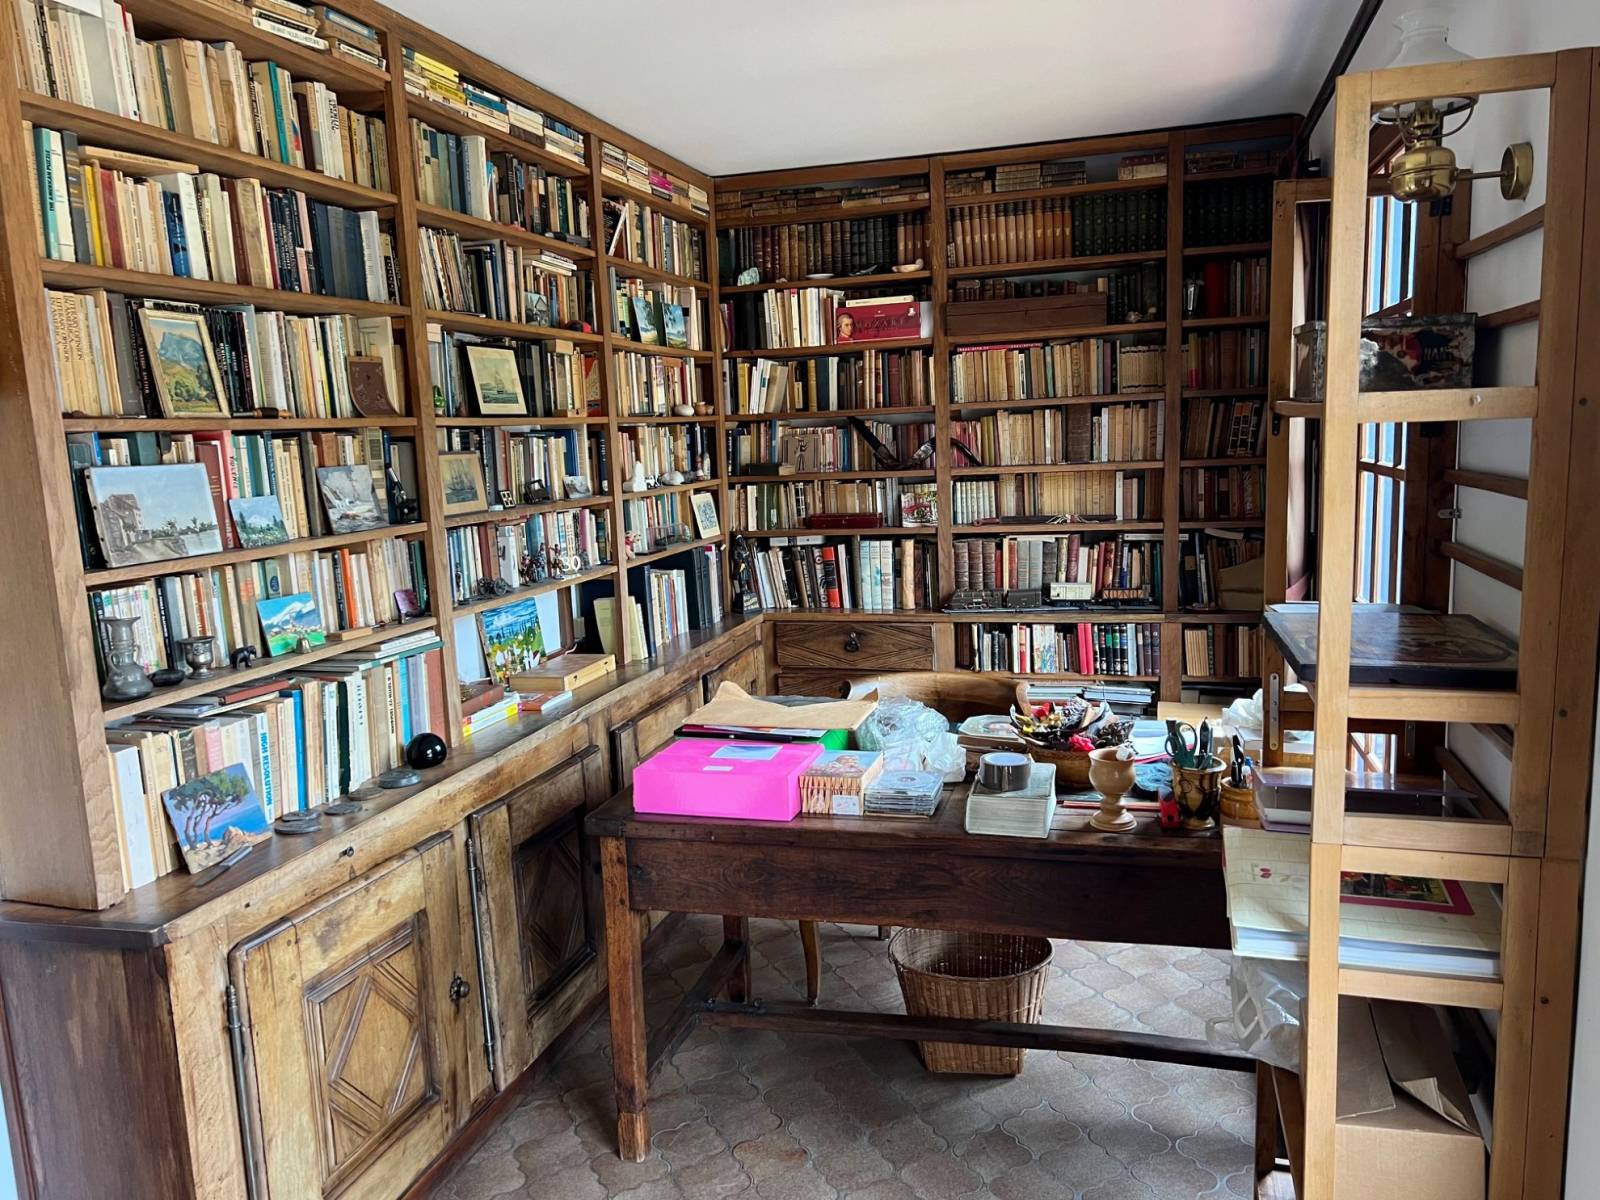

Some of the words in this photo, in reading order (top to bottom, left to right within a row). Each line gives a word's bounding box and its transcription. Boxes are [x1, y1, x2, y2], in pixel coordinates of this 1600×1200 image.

[56, 297, 65, 331] LITERARY
[61, 332, 69, 363] OPINION
[69, 296, 79, 329] LITERARY
[75, 330, 84, 361] OPINION
[260, 732, 268, 754] HIGH
[262, 755, 273, 807] RESOLUTION
